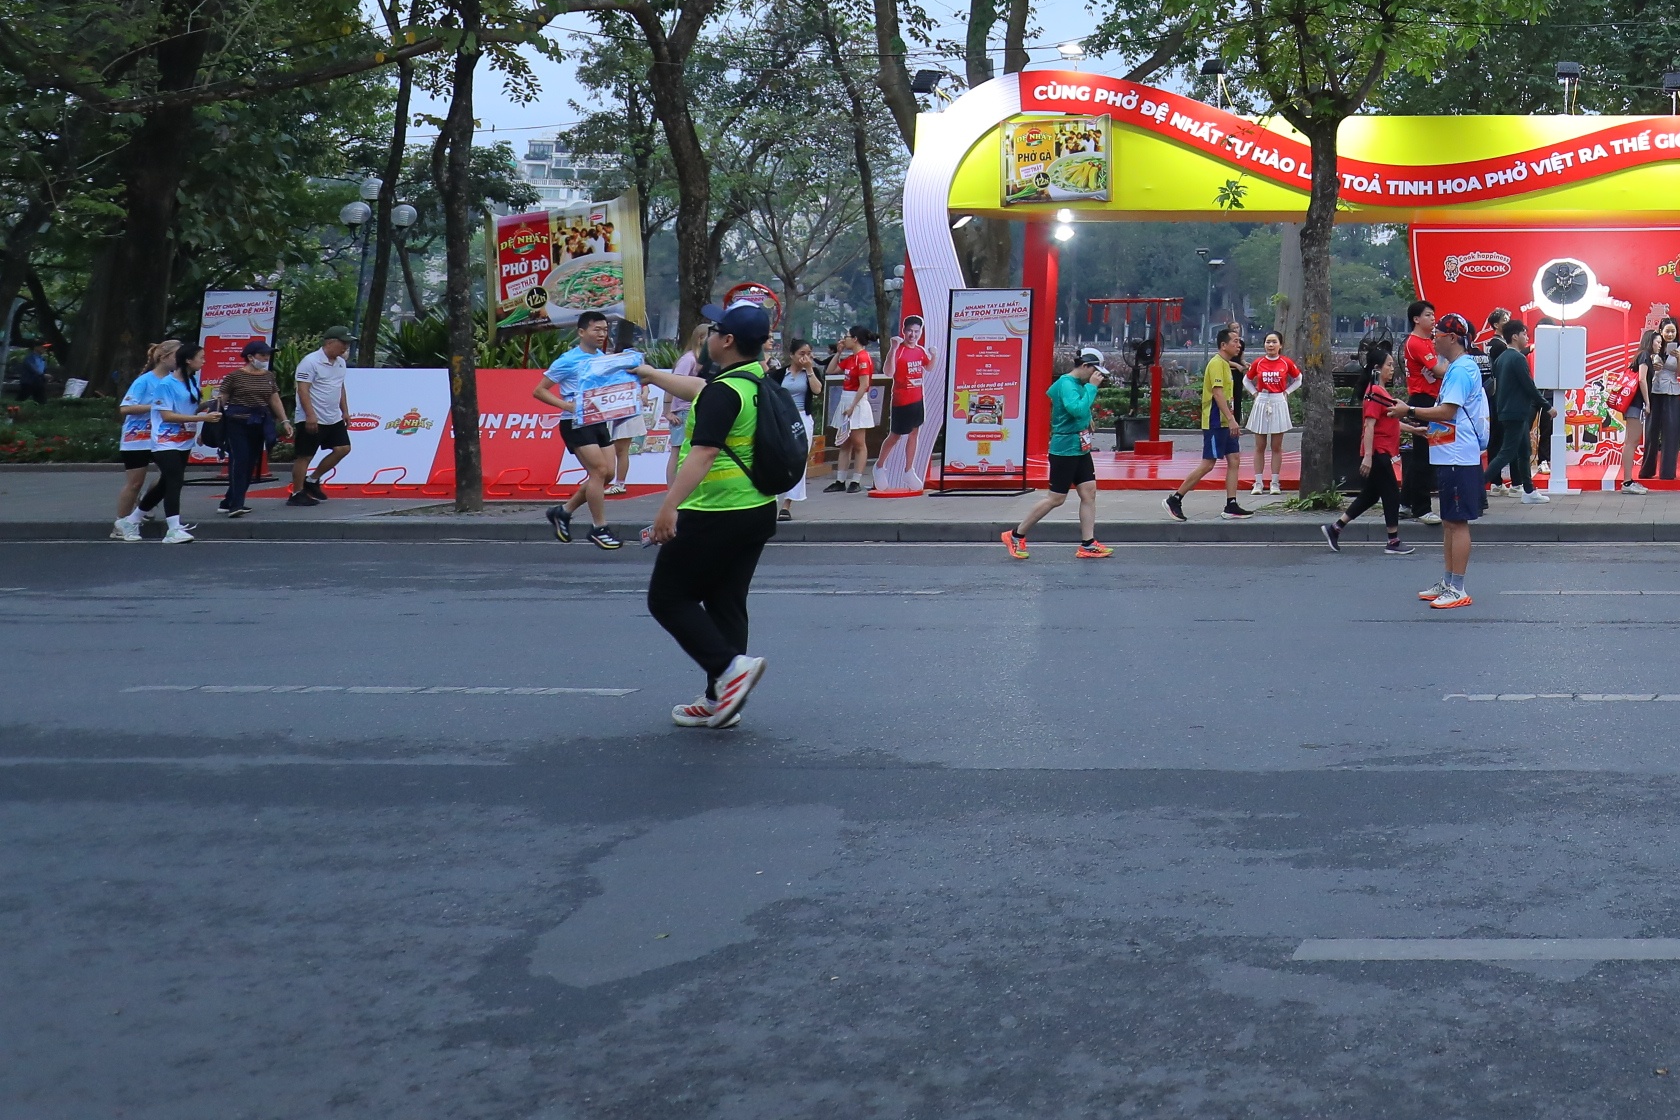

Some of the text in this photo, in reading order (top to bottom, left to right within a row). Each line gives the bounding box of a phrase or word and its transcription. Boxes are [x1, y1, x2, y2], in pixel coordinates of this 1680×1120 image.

[1033, 81, 1090, 102] CÙNG
[1094, 86, 1139, 111] PHỞ
[1140, 99, 1171, 125] ĐỆ
[1169, 111, 1224, 146] NHẤT
[1224, 133, 1254, 160] TỰ
[1251, 146, 1296, 173] HÀO
[1342, 172, 1382, 194] TOẢ
[1386, 179, 1433, 195] TINH
[1438, 177, 1482, 195] HOA
[1486, 160, 1528, 187] PHỞ
[1532, 152, 1576, 176] VIỆT
[1578, 143, 1610, 163] RA
[1609, 129, 1652, 155] THẾ
[1017, 149, 1052, 163] PHỞ GÀ
[500, 231, 549, 251] ĐỆ NHẤT
[1459, 252, 1510, 263] Cook happiness
[502, 255, 549, 277] PHỞ BÒ
[1658, 262, 1675, 276] ĐỆ
[600, 391, 633, 405] 5042
[402, 417, 433, 430] NHẤT
[511, 430, 552, 439] NAM
